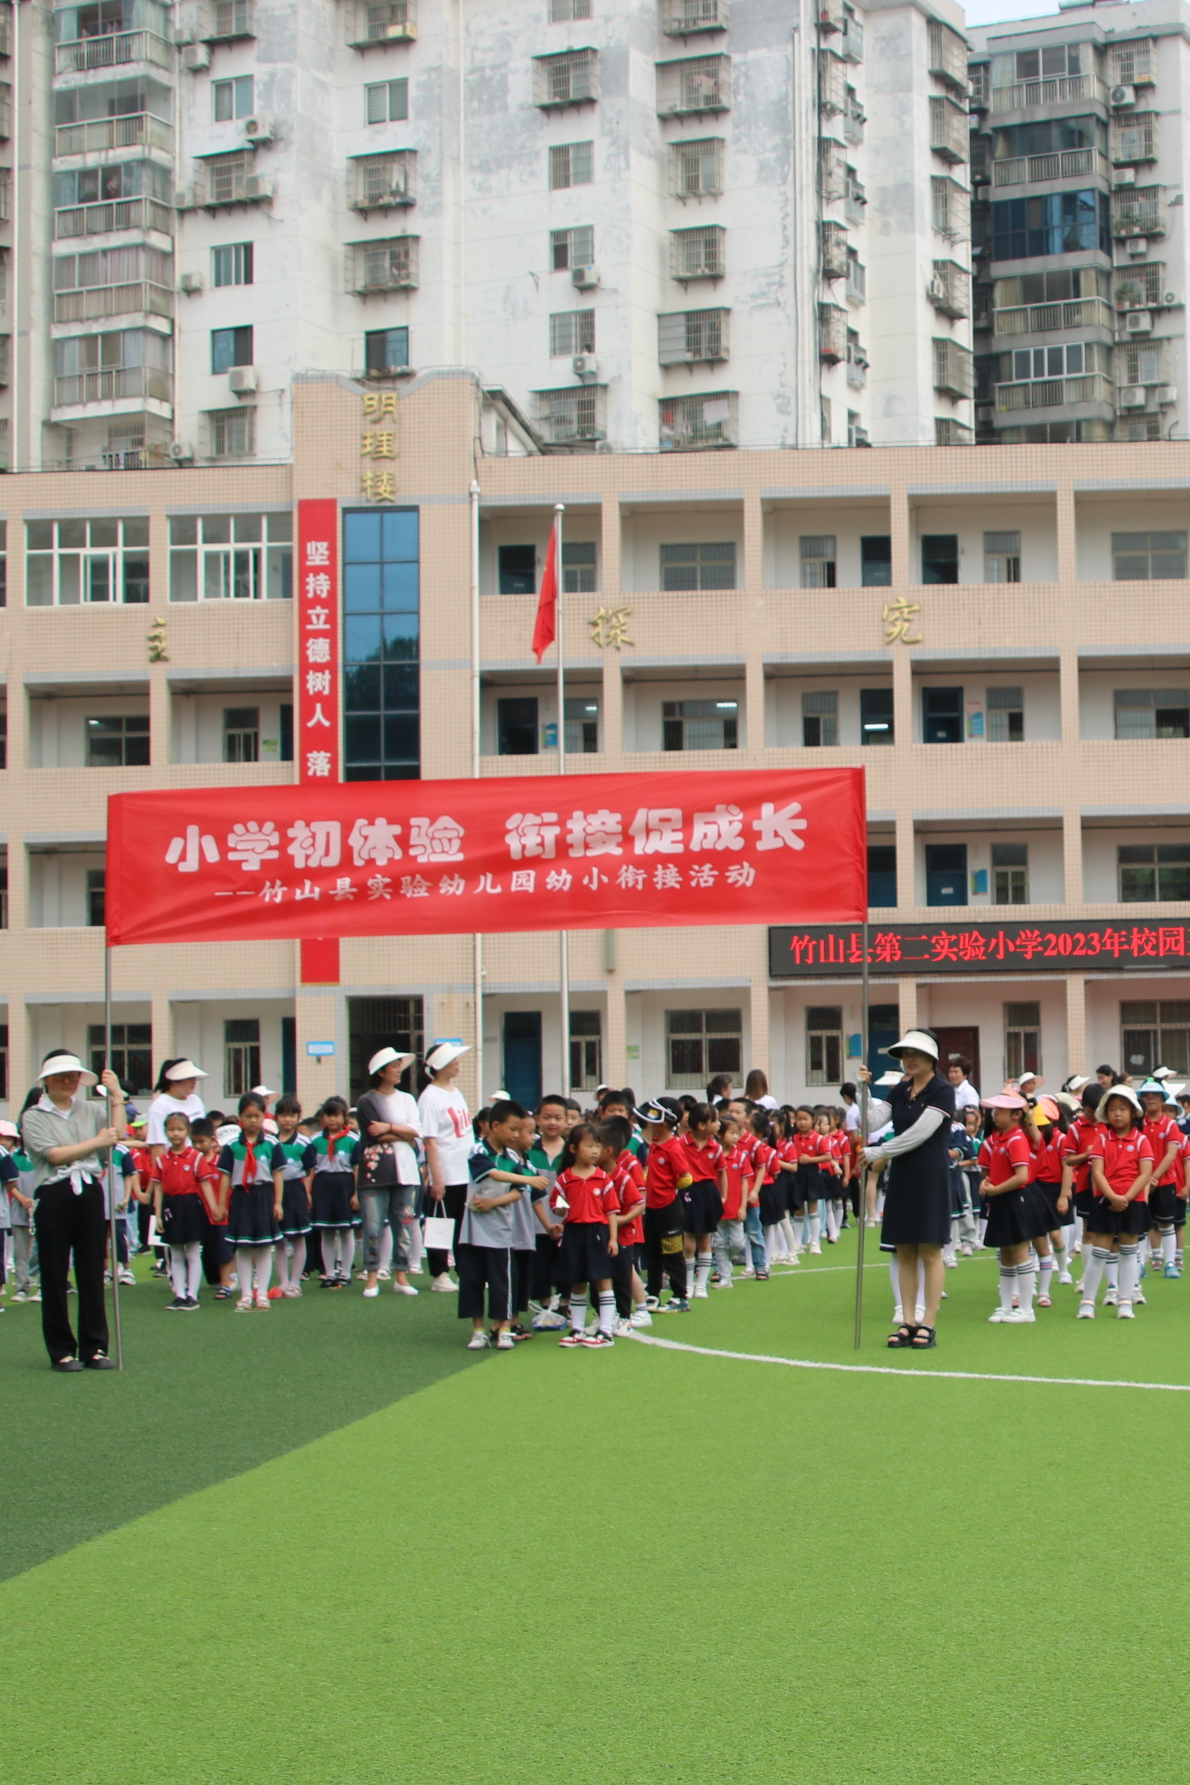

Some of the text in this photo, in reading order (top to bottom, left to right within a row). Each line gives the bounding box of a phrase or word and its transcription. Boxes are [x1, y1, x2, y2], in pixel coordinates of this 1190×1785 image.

[360, 392, 398, 502] 明理楼
[305, 540, 331, 728] 坚持立德树人
[881, 596, 924, 645] 究
[165, 802, 808, 872] 小学初体验 衔接促成长
